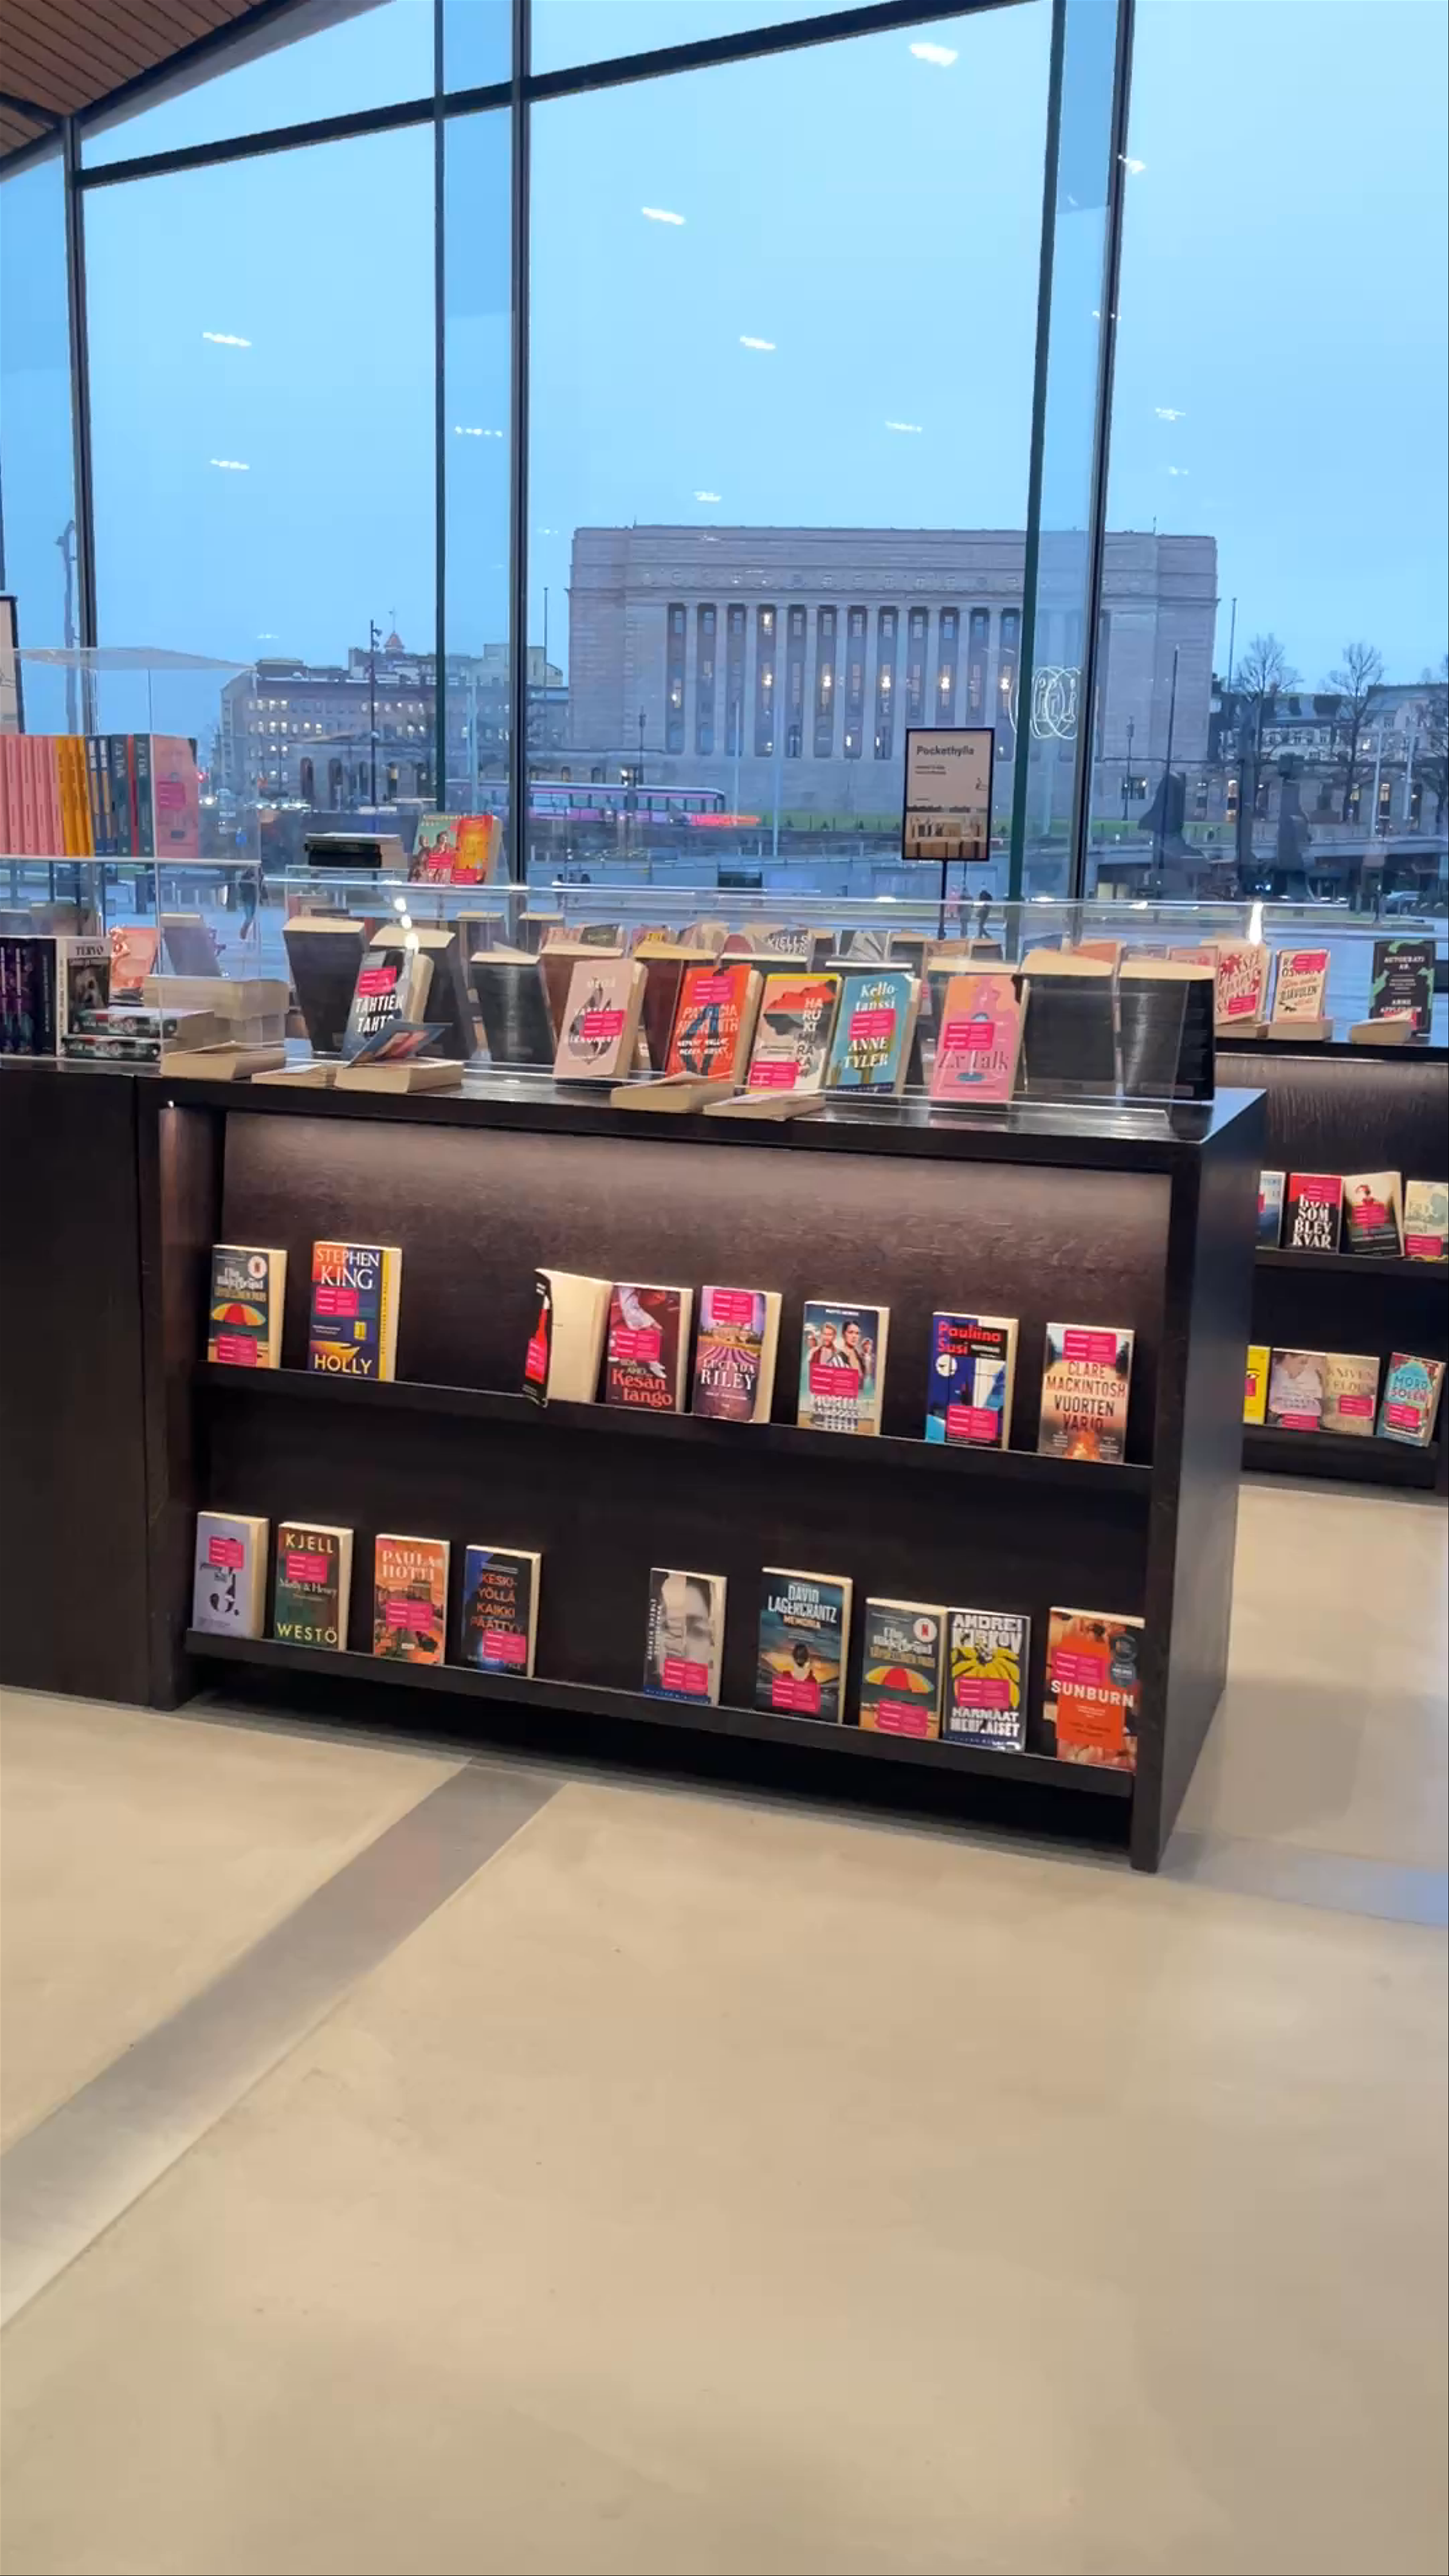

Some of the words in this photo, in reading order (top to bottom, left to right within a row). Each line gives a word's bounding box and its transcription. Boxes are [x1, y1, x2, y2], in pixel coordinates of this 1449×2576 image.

[917, 745, 974, 758] Pockethylla
[805, 997, 823, 1009] HA
[803, 1009, 822, 1020] RU
[357, 1015, 394, 1032] TAHT
[803, 1021, 820, 1032] KI
[796, 1044, 813, 1055] RA
[848, 1037, 887, 1052] ANNE
[843, 1053, 888, 1068] TYLER
[1298, 1207, 1329, 1221] SOM
[1294, 1219, 1332, 1234] BLEV
[1292, 1233, 1332, 1250] KVAR
[317, 1249, 380, 1267] STEPHEN
[321, 1265, 373, 1290] KING
[938, 1320, 1002, 1342] Pauliina
[938, 1337, 968, 1355] Susi
[314, 1354, 372, 1375] HOLLY
[703, 1359, 755, 1374] LUCINDA
[1068, 1362, 1106, 1378] CLARE
[701, 1369, 756, 1390] RILEY
[1046, 1376, 1126, 1398] MACKINTOSH
[623, 1387, 673, 1407] tango
[1054, 1395, 1115, 1416] VUORTEN
[285, 1533, 334, 1554] KJELL
[383, 1550, 435, 1567] PAULA
[382, 1565, 434, 1581] HOTTI
[788, 1584, 819, 1603] DAVID
[477, 1604, 515, 1618] KAIKKI
[768, 1595, 837, 1624] LAGERCRANTZ
[953, 1614, 1022, 1632] ANDREI
[277, 1623, 337, 1644] WESTÖ
[1051, 1679, 1134, 1707] SUNBURN
[952, 1706, 1020, 1722] HARMAAT
